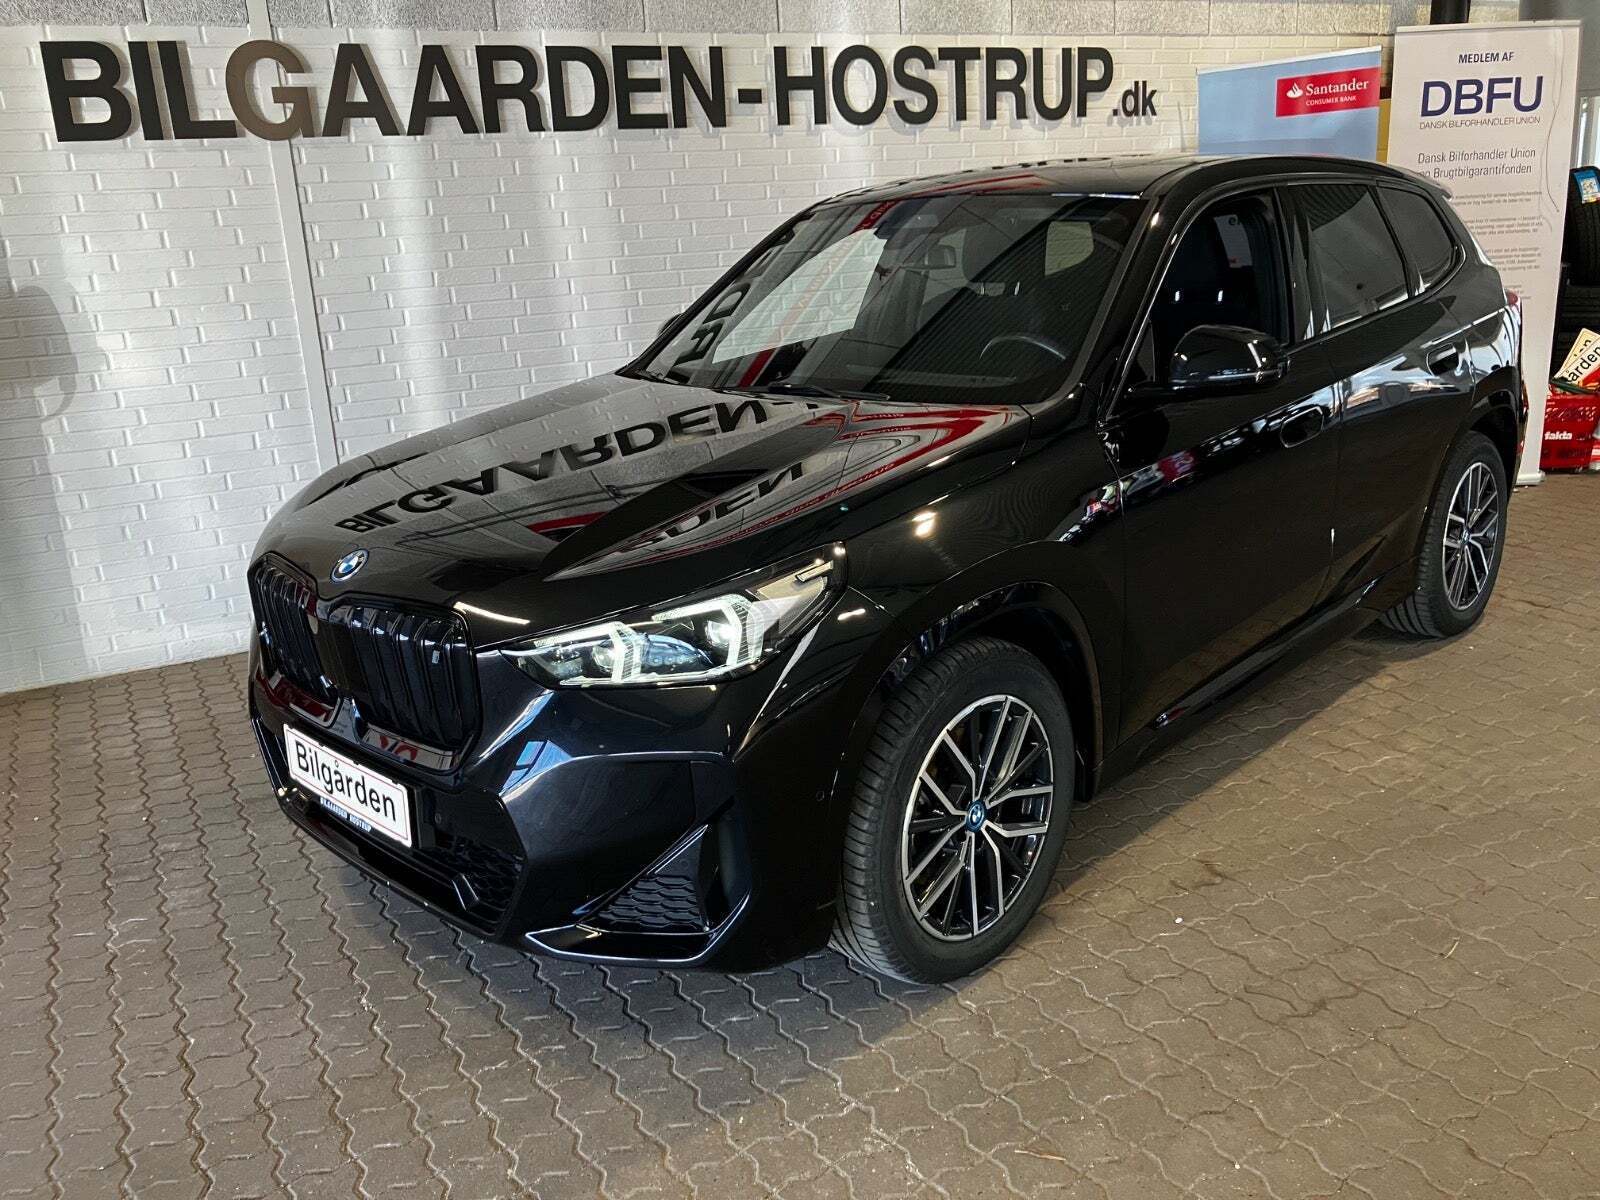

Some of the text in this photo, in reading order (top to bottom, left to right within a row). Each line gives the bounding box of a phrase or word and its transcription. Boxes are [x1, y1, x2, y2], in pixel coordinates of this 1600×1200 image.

[1458, 51, 1515, 64] MEDLEM AF
[40, 40, 1158, 142] BILGAARDEN-HOSTRUP.dk
[1305, 78, 1369, 96] Santander
[1421, 76, 1544, 117] DBFU
[1419, 116, 1541, 130] DANSK BILFORHANDLER UNION
[1418, 147, 1536, 163] Dansk Bilforhandler Union
[1433, 164, 1532, 180] Brugtbilgarantifonden
[294, 740, 397, 822] Bilgården
